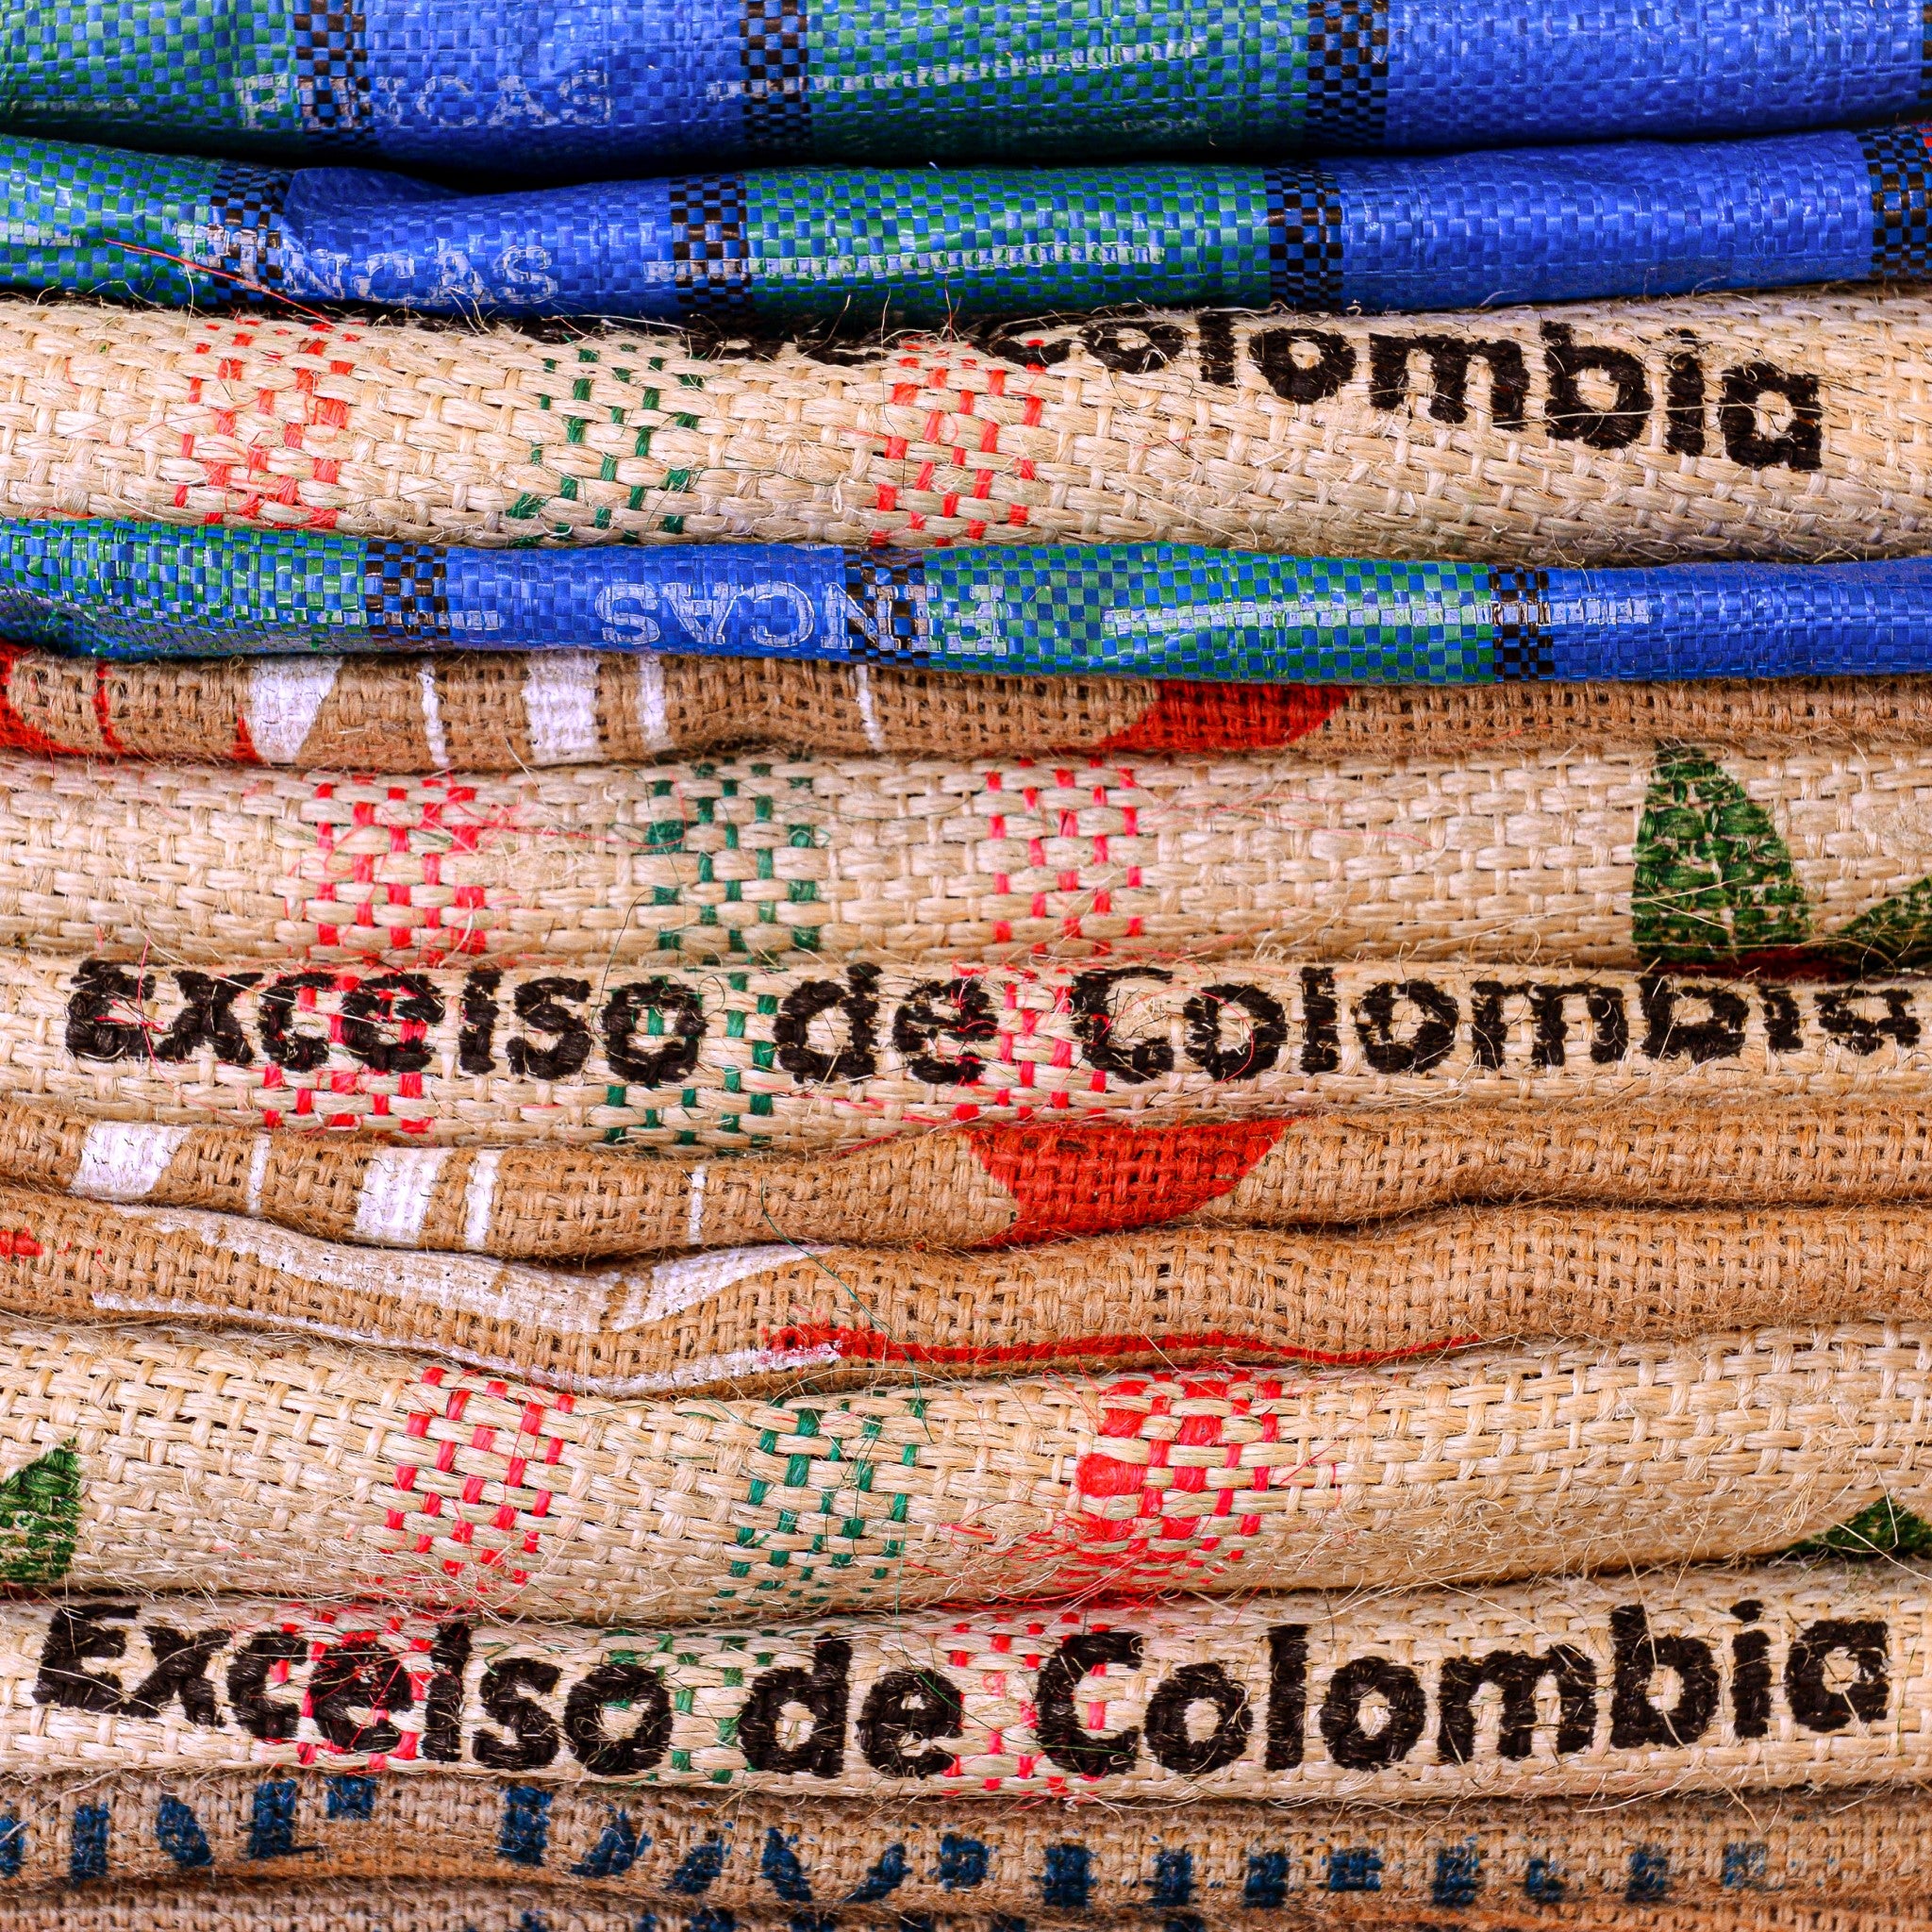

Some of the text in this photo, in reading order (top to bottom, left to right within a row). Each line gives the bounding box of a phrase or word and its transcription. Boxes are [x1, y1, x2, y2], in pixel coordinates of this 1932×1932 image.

[594, 579, 1008, 658] FINCAS
[774, 960, 1000, 1085] de
[31, 1598, 1889, 1779] Excelso de Colombia
